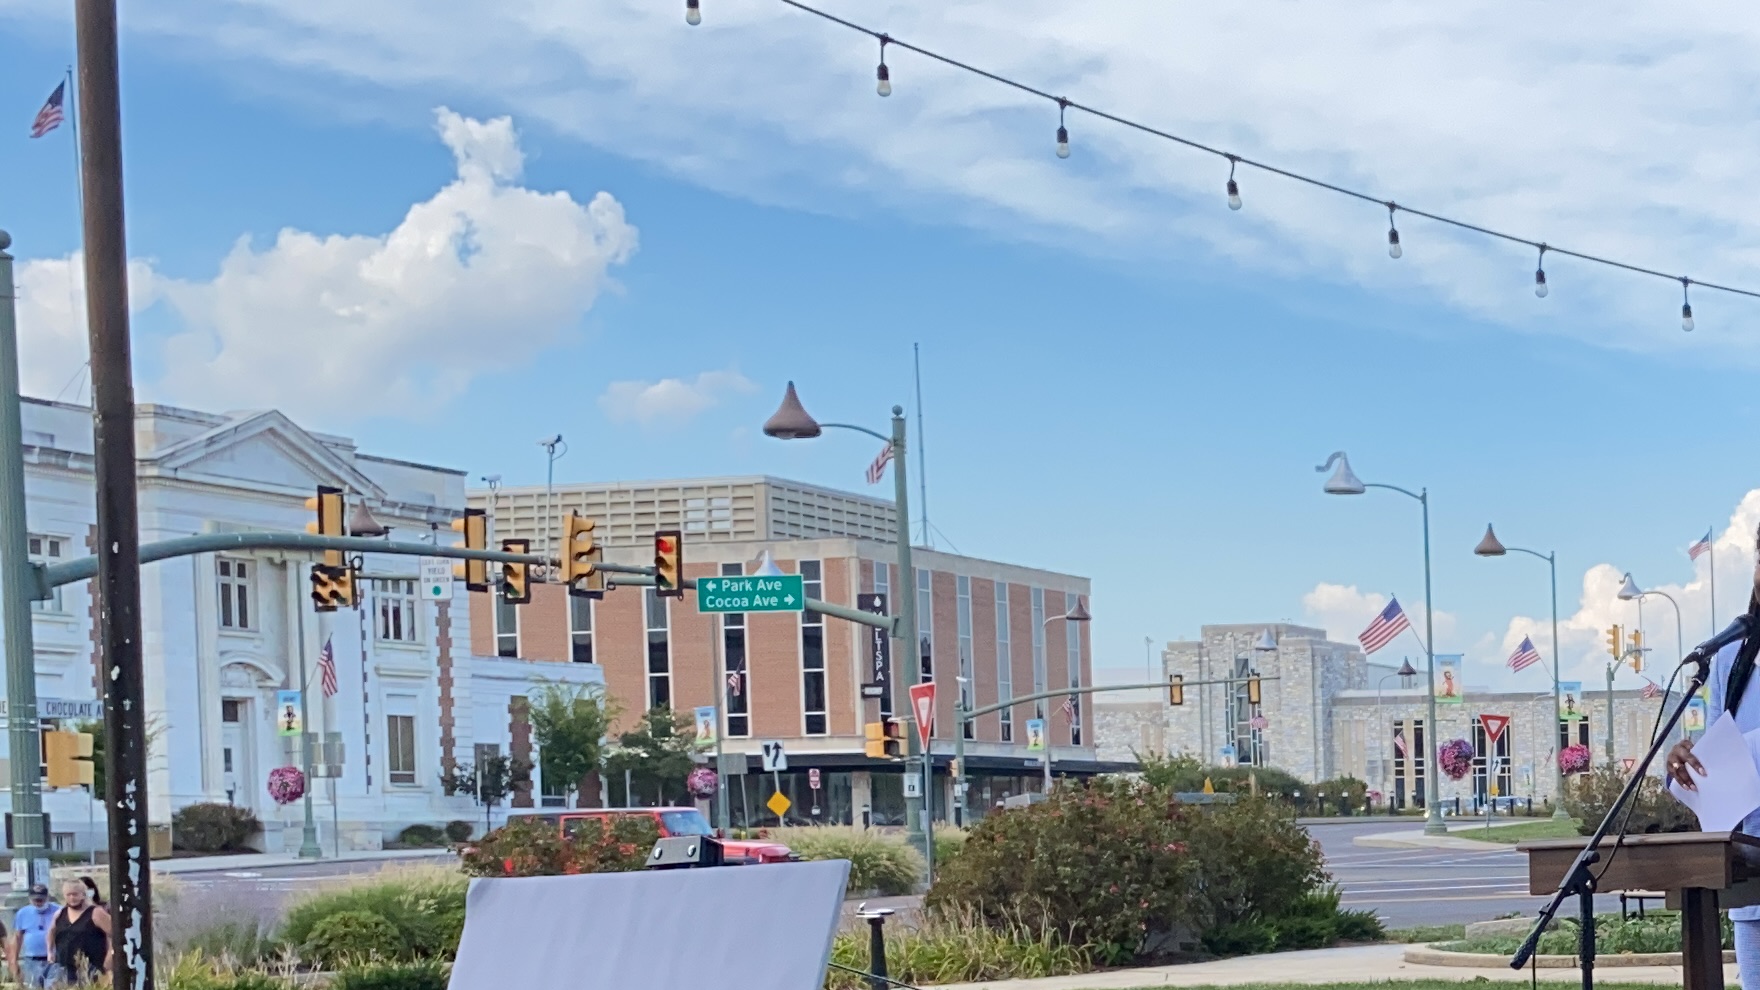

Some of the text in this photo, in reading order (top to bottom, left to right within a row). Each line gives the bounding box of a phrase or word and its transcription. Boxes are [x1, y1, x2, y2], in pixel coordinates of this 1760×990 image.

[721, 579, 782, 592] Park Ave
[705, 594, 779, 608] Cocoa Ave
[46, 701, 92, 717] CHOCOLATE
